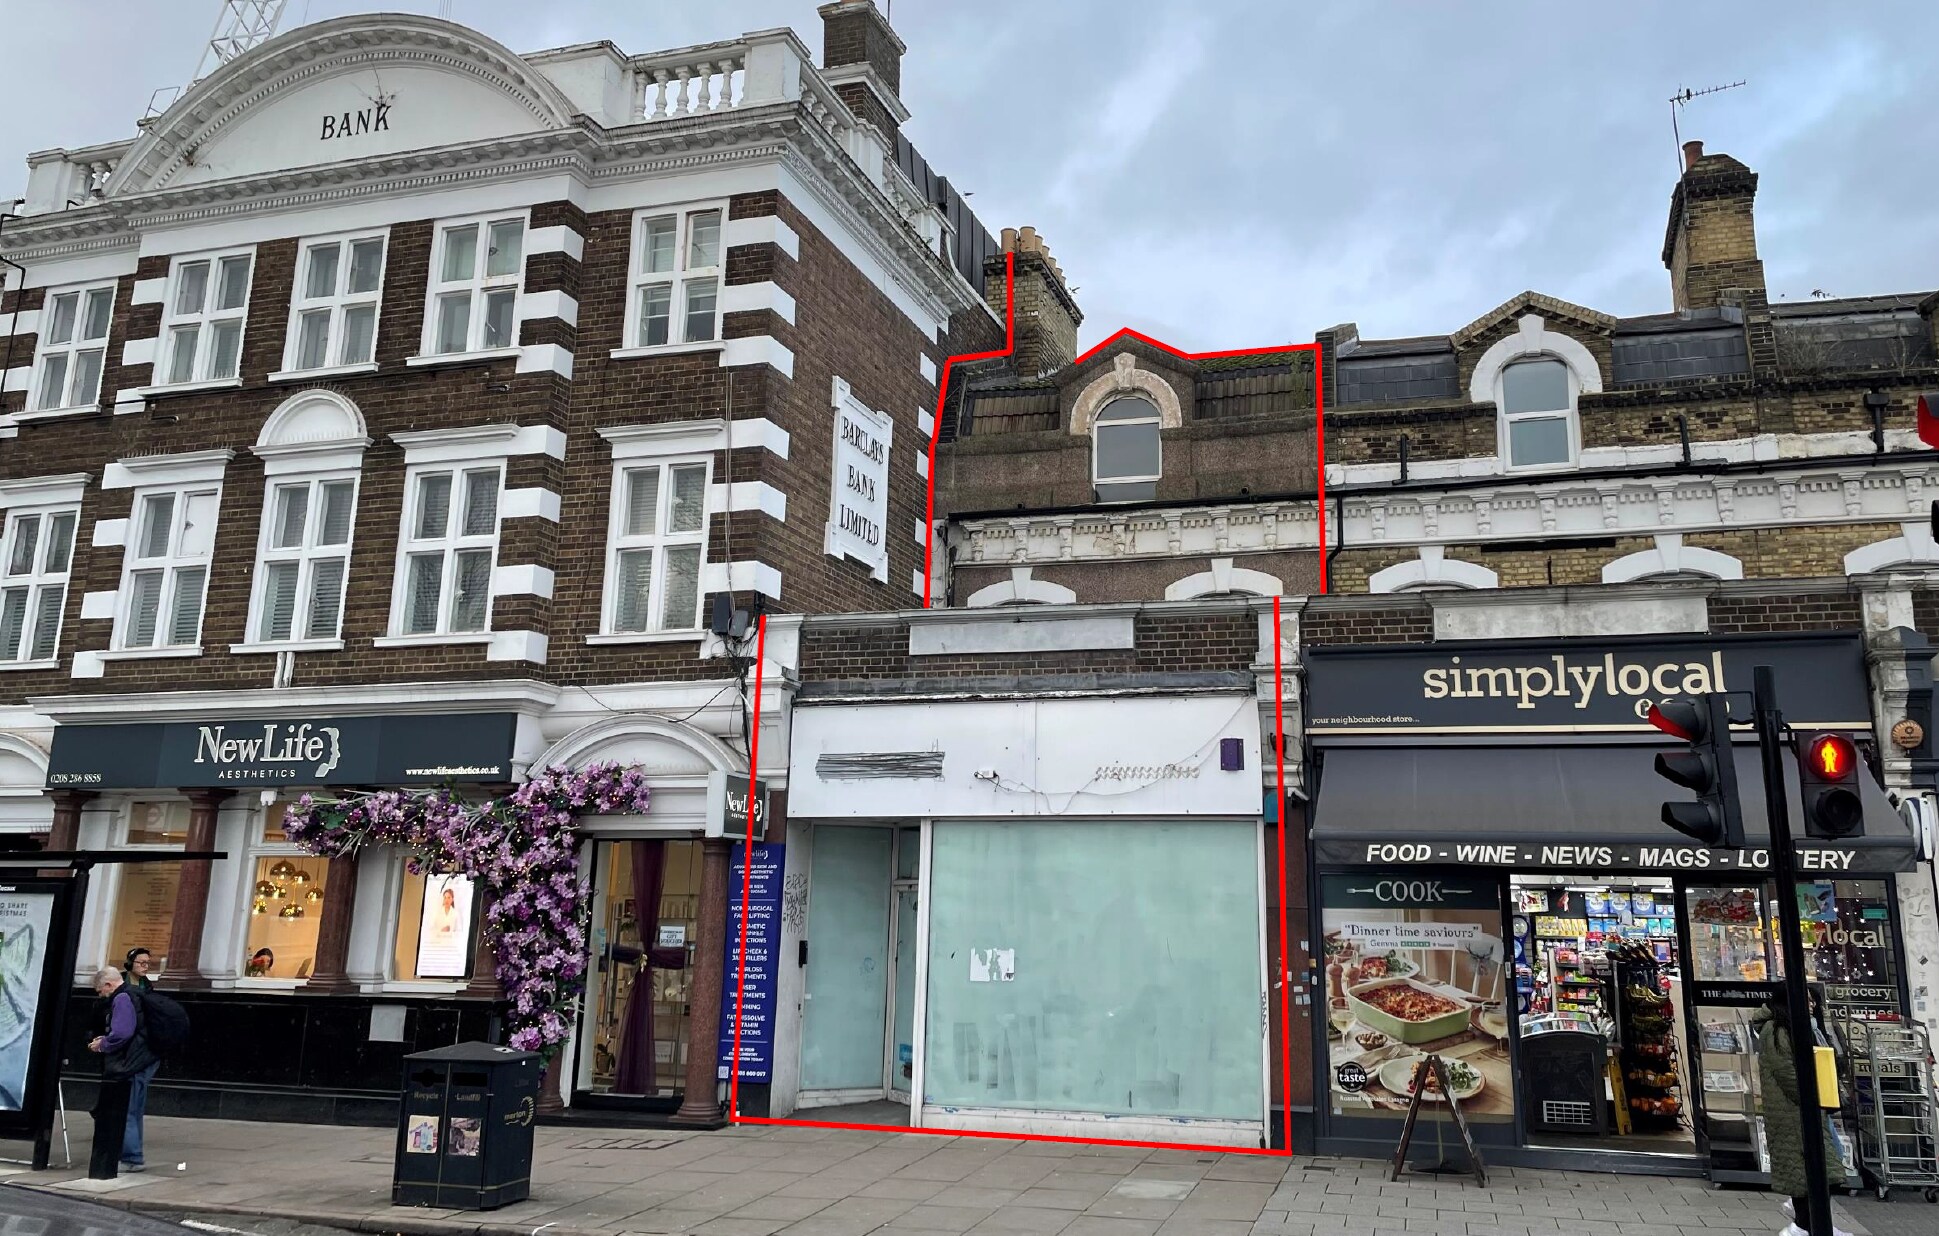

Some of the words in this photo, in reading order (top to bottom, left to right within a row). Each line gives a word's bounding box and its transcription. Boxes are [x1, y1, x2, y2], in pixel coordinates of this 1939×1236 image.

[320, 105, 392, 140] BANK
[840, 415, 884, 465] BARCLAYS
[846, 464, 876, 502] BANK
[839, 503, 879, 546] LIMITED
[1311, 717, 1329, 725] your
[1330, 715, 1392, 725] neighbourhood
[50, 773, 68, 783] 0208
[218, 769, 296, 779] AESTHETICS
[726, 791, 759, 814] NewLe
[1366, 844, 1432, 862] FOOD
[1456, 845, 1517, 864] WINE
[1541, 846, 1613, 866] NEWS
[1639, 848, 1711, 867] MAGS
[1737, 849, 1856, 870] LOERY
[1374, 880, 1444, 901] COOK
[1395, 925, 1420, 937] time
[1701, 990, 1721, 998] THE
[1744, 991, 1773, 999] TIMES
[1836, 988, 1892, 1000] grocery
[1859, 1062, 1901, 1073] mals
[1339, 1073, 1366, 1082] taste
[413, 1091, 439, 1100] Recycle
